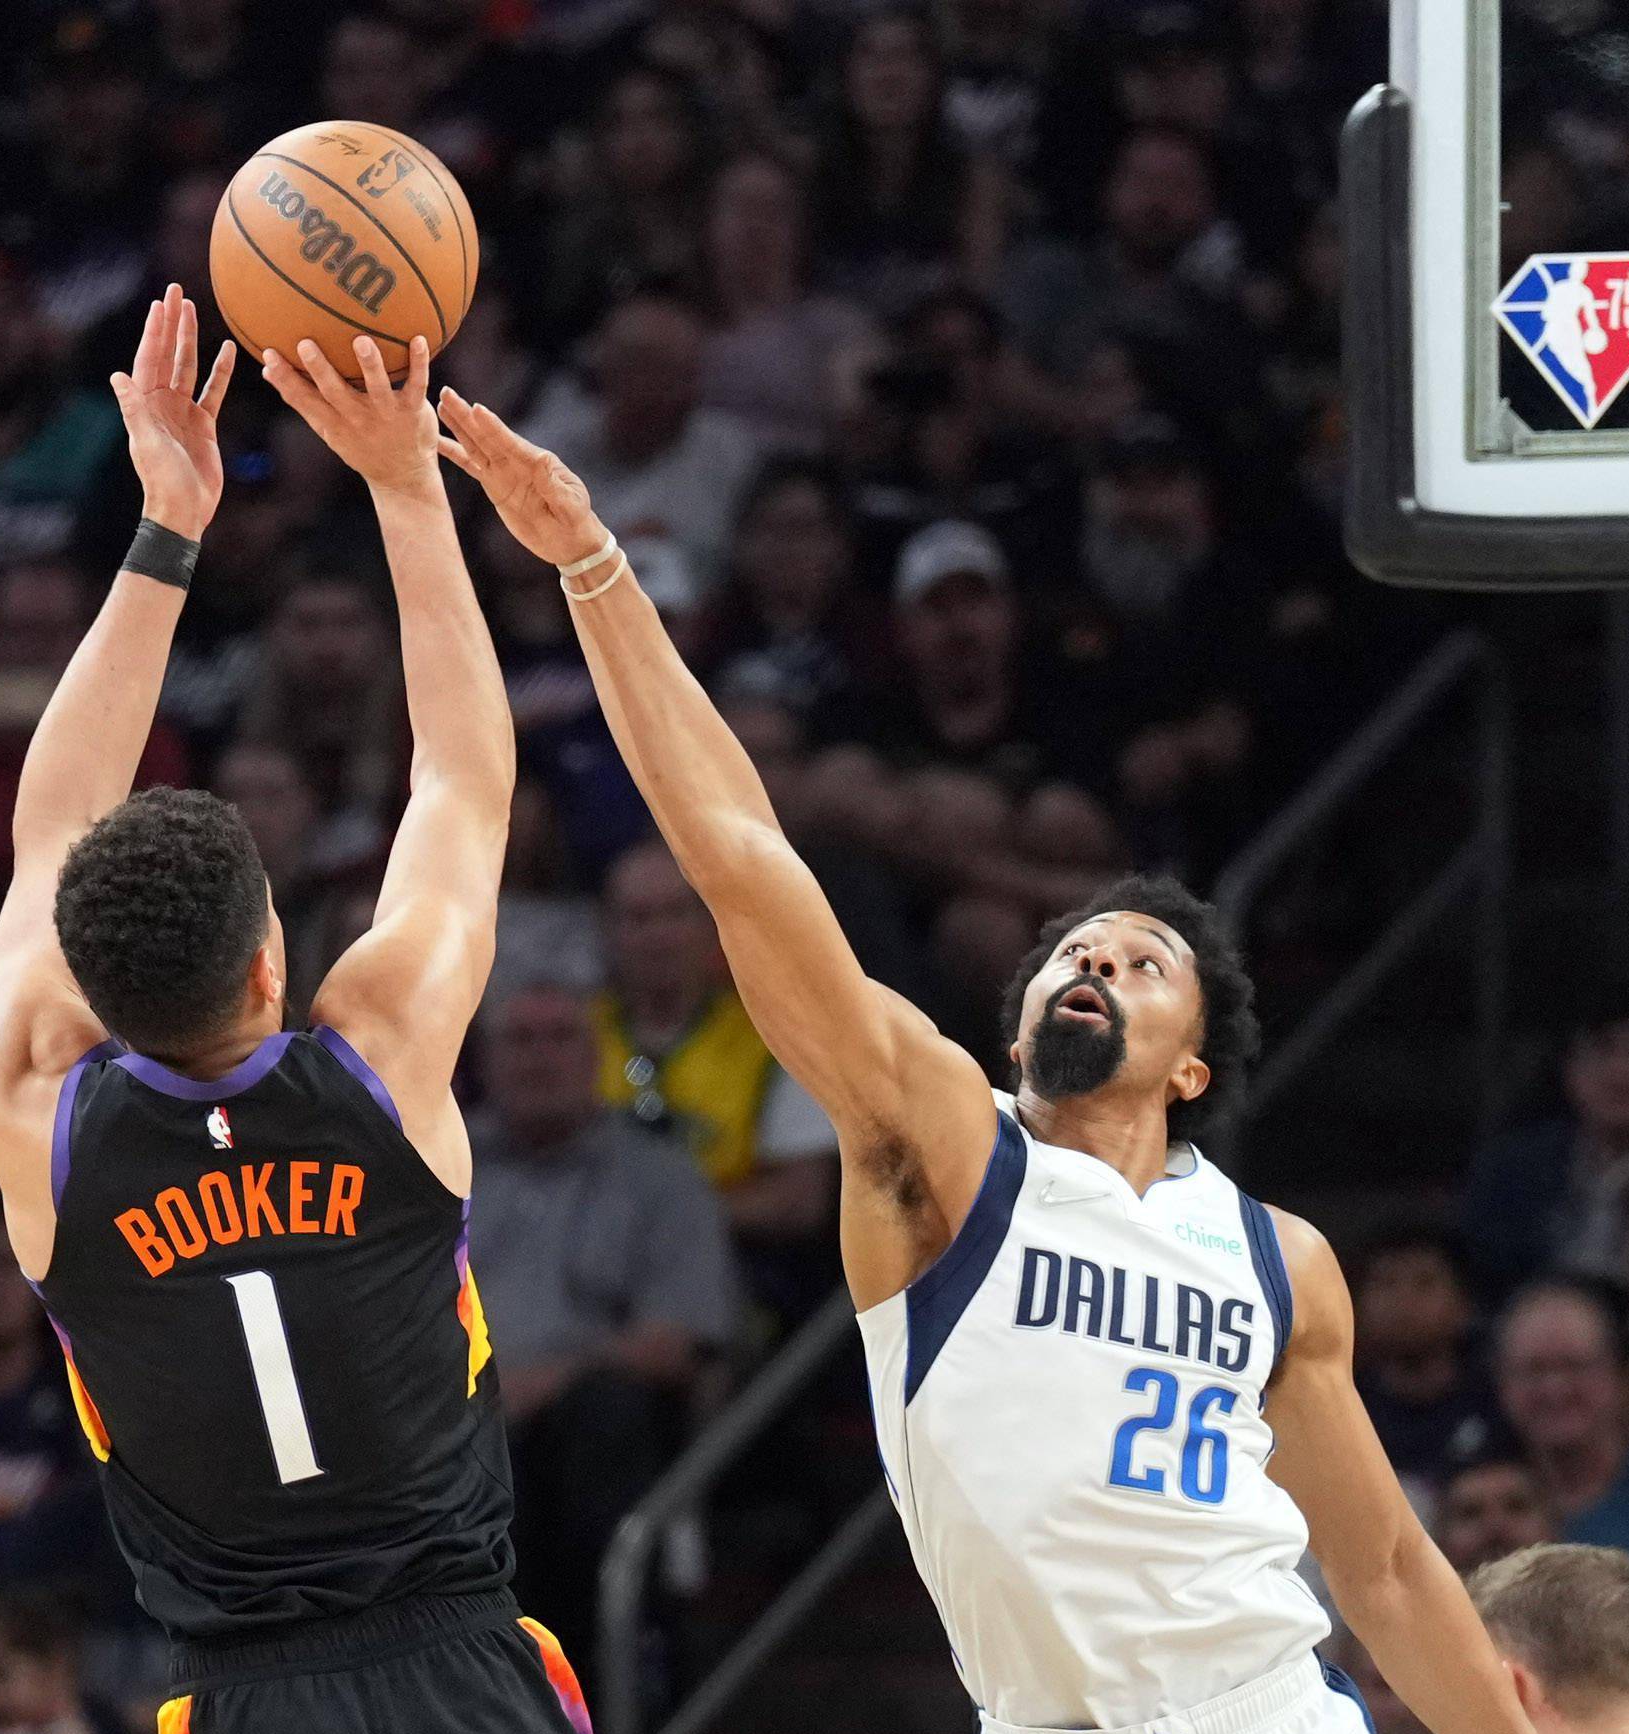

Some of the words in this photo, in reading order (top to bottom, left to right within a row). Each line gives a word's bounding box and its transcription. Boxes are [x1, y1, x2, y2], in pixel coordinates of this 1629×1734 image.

[258, 170, 398, 317] Wilson
[113, 1160, 366, 1279] BOOKER
[1173, 1220, 1244, 1257] chime
[1011, 1242, 1257, 1375] DALLAS
[219, 1270, 328, 1486] 1
[1106, 1366, 1242, 1507] 26
